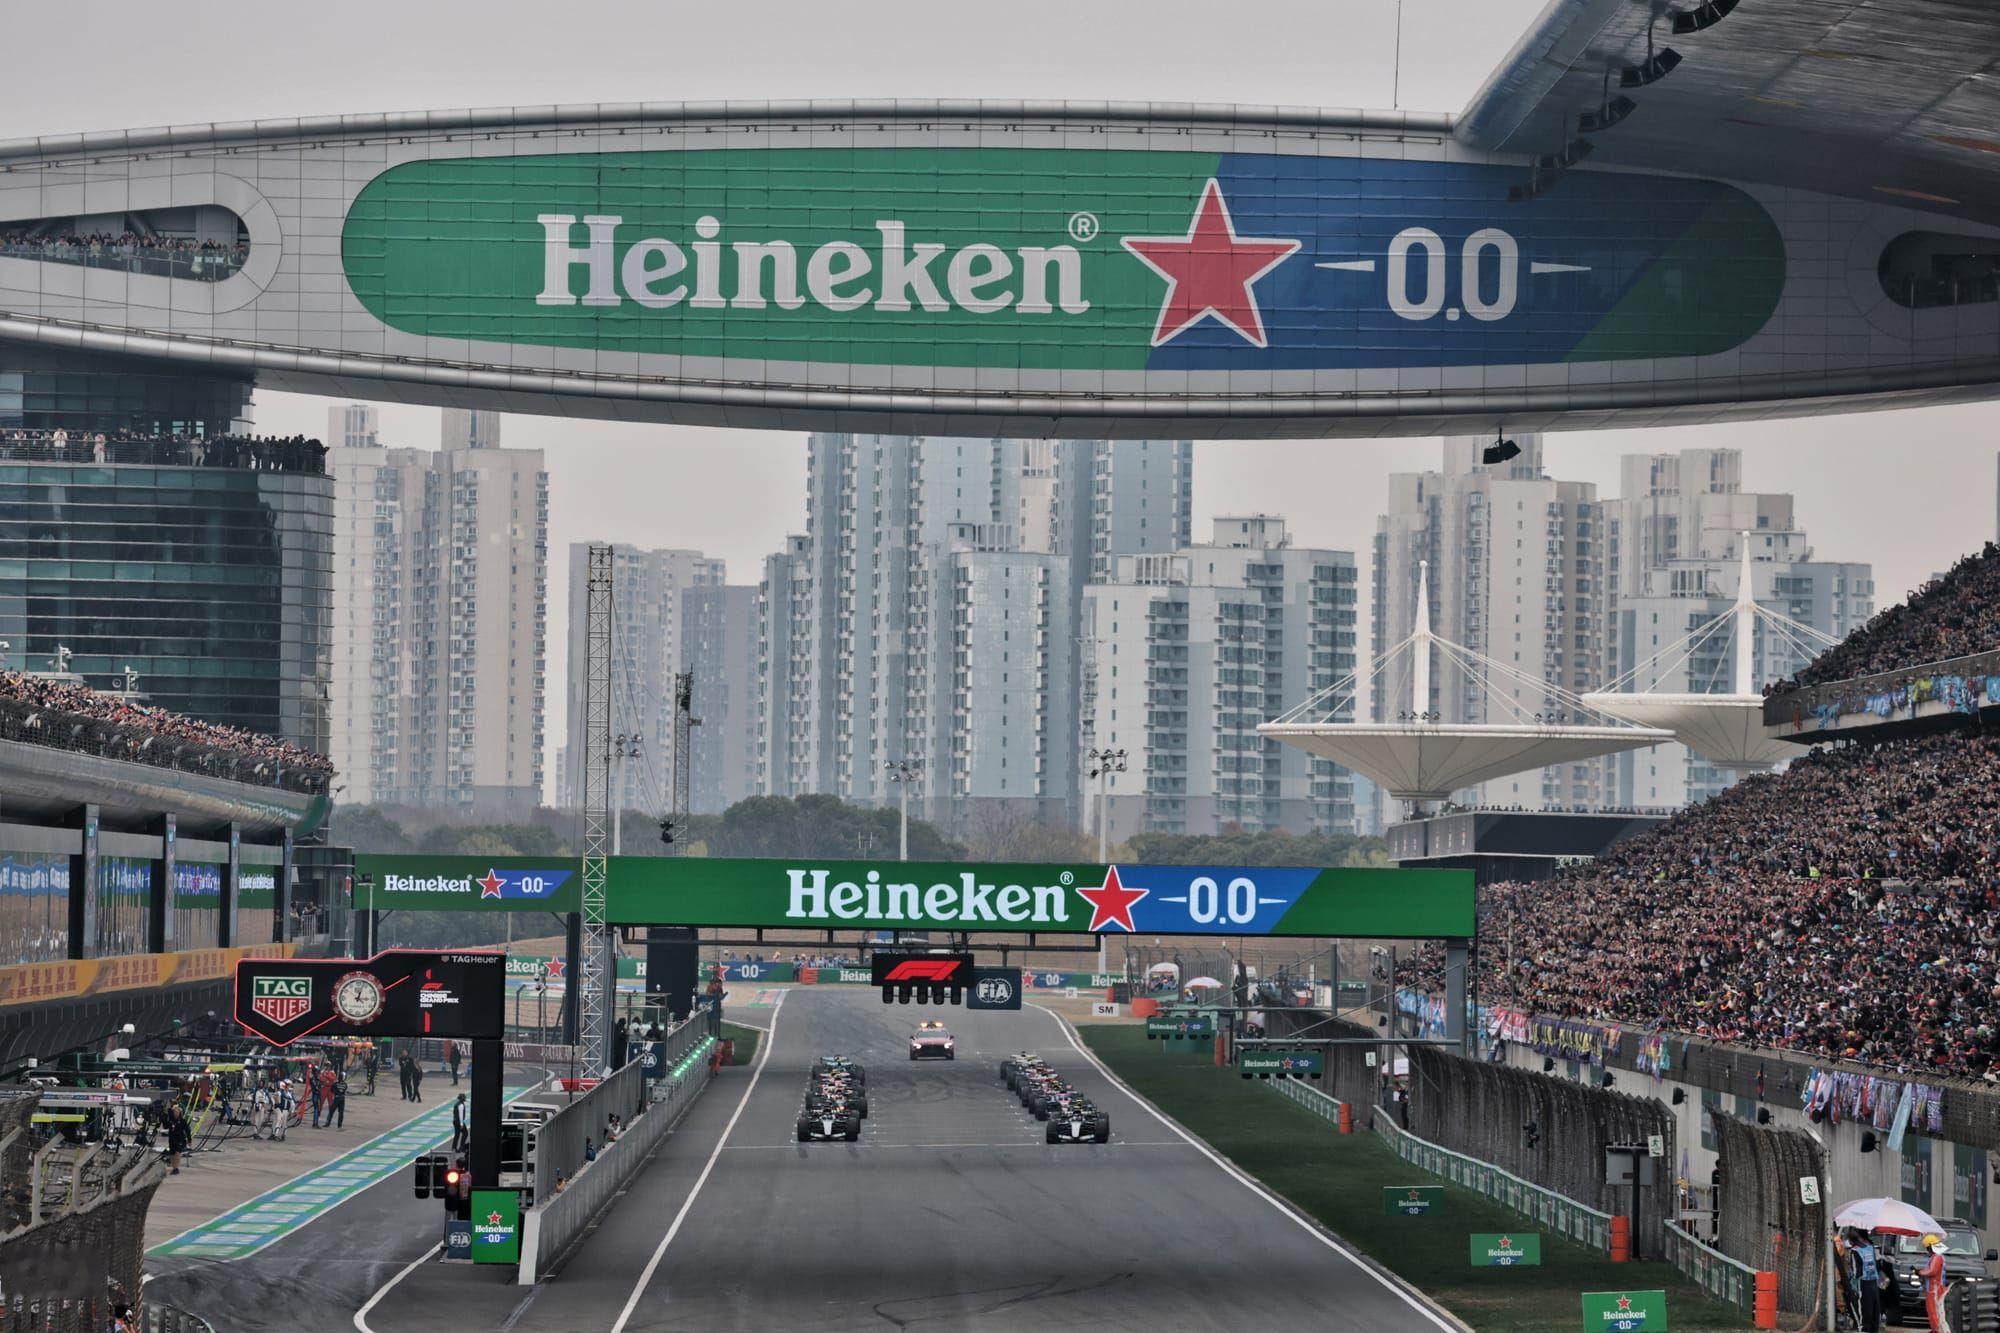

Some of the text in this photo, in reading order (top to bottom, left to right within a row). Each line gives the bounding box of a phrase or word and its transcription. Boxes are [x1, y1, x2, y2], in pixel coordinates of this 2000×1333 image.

[1387, 226, 1519, 322] 0.0
[384, 873, 544, 894] Heineken 0.0
[1188, 876, 1257, 925] 0.0
[505, 959, 539, 973] eken
[839, 970, 872, 982] Heine
[258, 980, 307, 995] TAG
[255, 999, 309, 1022] HEUER
[1098, 1005, 1114, 1015] SM
[475, 1224, 514, 1233] Heineken
[1488, 1248, 1524, 1257] Heineken
[1603, 1309, 1646, 1320] Heineken
